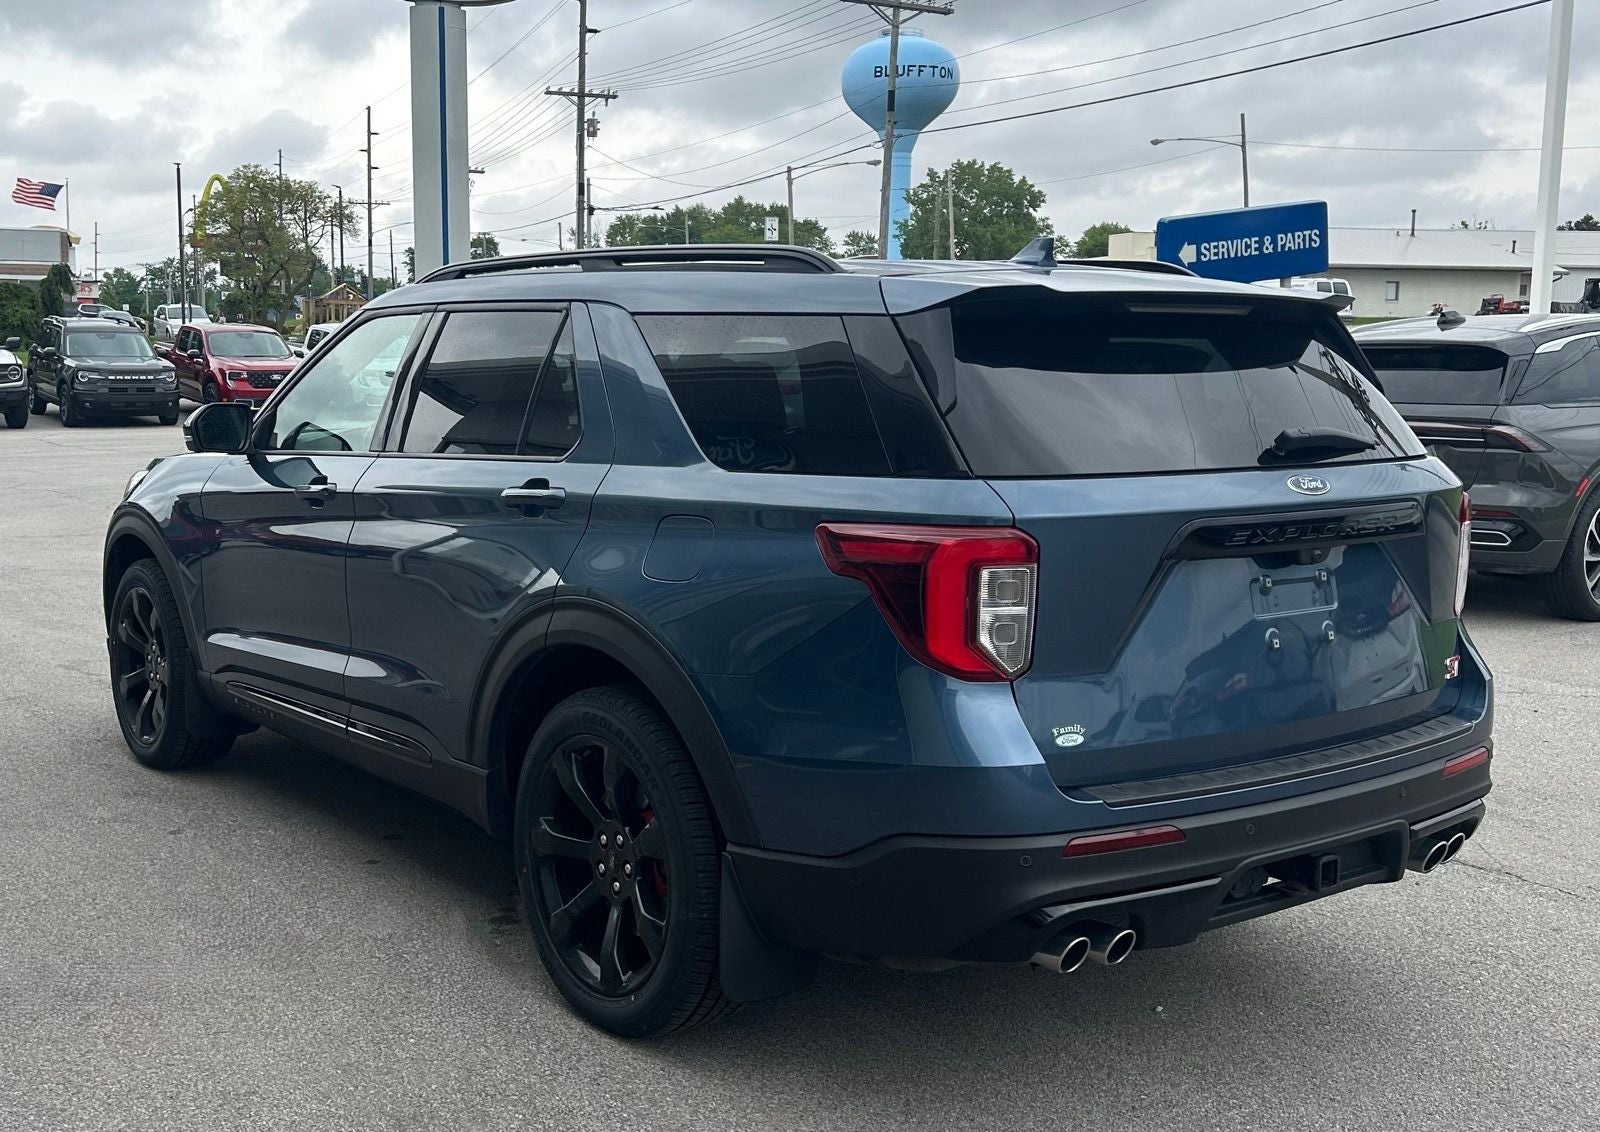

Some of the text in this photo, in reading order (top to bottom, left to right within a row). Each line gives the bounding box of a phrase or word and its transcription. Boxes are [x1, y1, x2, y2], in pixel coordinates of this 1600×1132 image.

[873, 65, 954, 80] BLUFFTON
[1200, 229, 1320, 262] SERVICE & PARTS
[1299, 476, 1324, 490] Ford
[1225, 516, 1398, 546] EXPLORER
[1444, 655, 1461, 680] ST
[1051, 723, 1087, 737] Family
